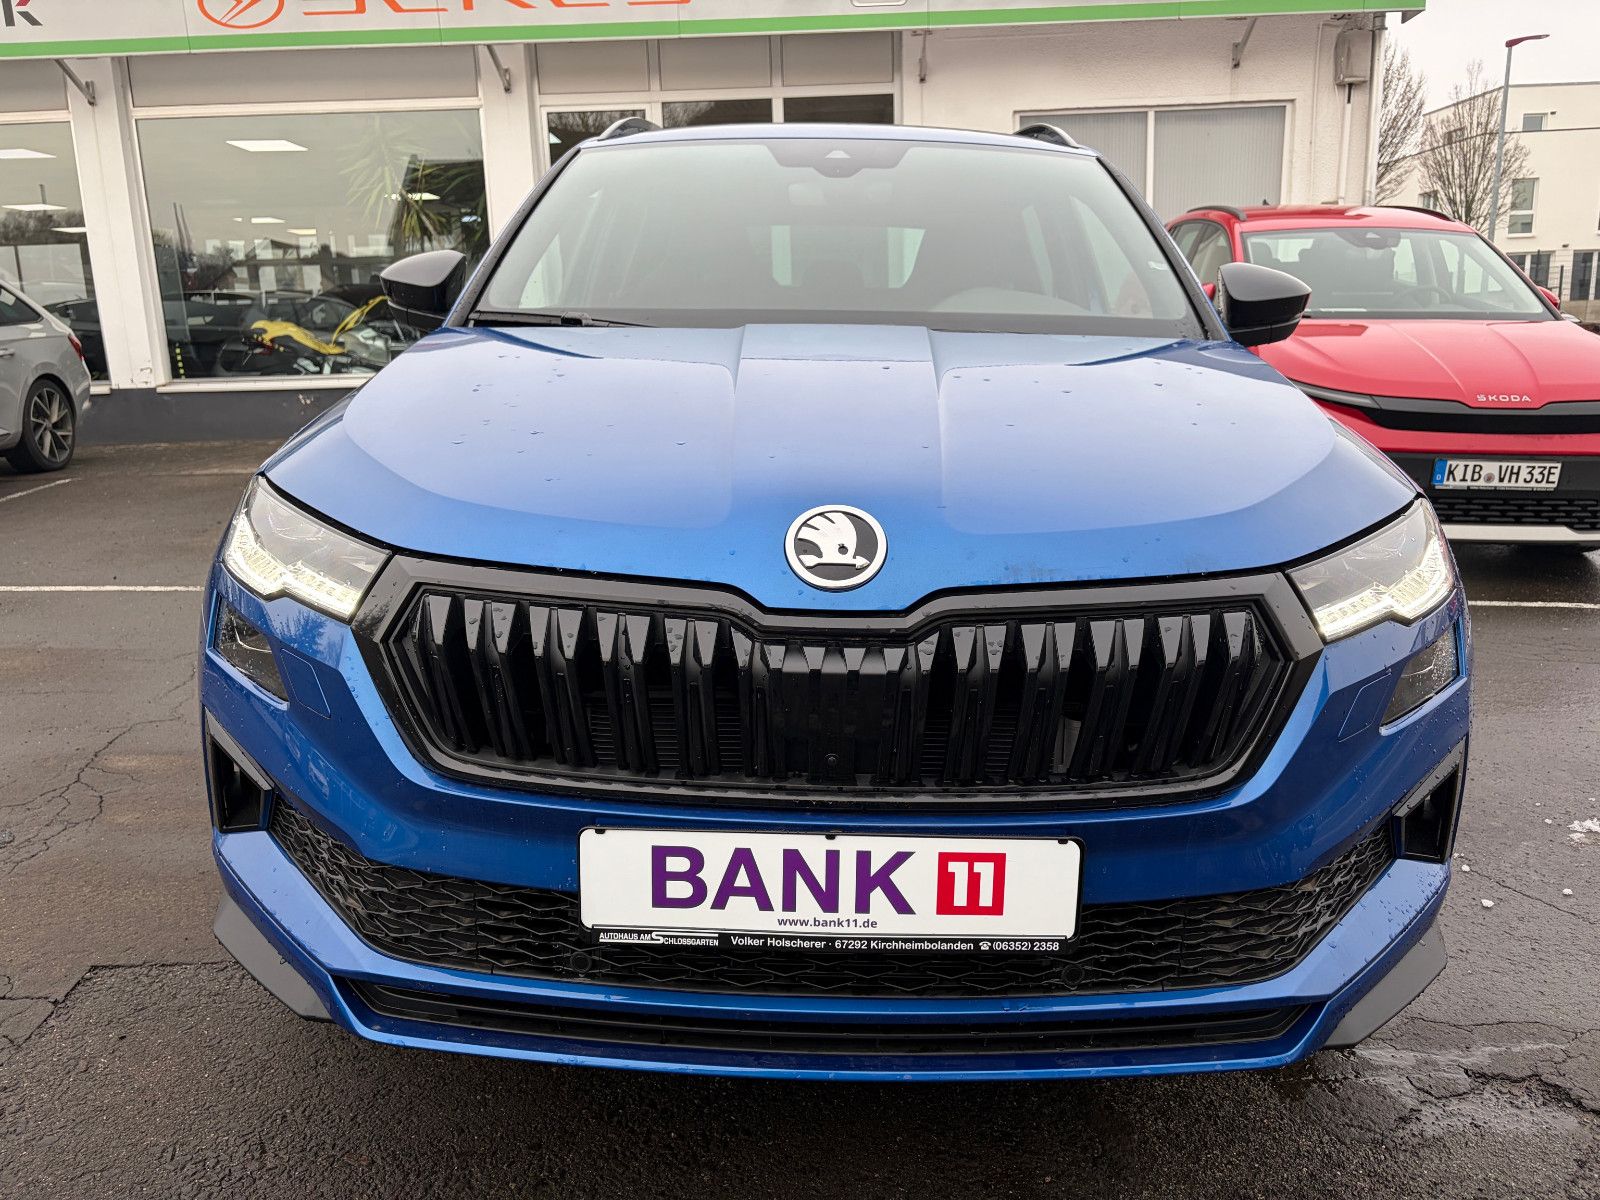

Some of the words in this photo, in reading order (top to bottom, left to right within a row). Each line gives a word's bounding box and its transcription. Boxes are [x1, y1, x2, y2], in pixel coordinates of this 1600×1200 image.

[1446, 463, 1483, 482] KIB
[651, 844, 917, 916] BANK
[945, 858, 997, 910] 11
[777, 917, 878, 929] www.bank11.de
[599, 931, 639, 941] AUTOHAUS
[640, 933, 651, 941] AM
[651, 931, 719, 947] SCHLOSSGARTEN
[730, 935, 765, 946] Volker
[767, 937, 827, 949] Holscherer
[834, 939, 868, 950] 67292
[870, 940, 974, 951] Kirchheimbolanden
[992, 941, 1032, 951] (06352)
[1033, 941, 1060, 951] 2358
